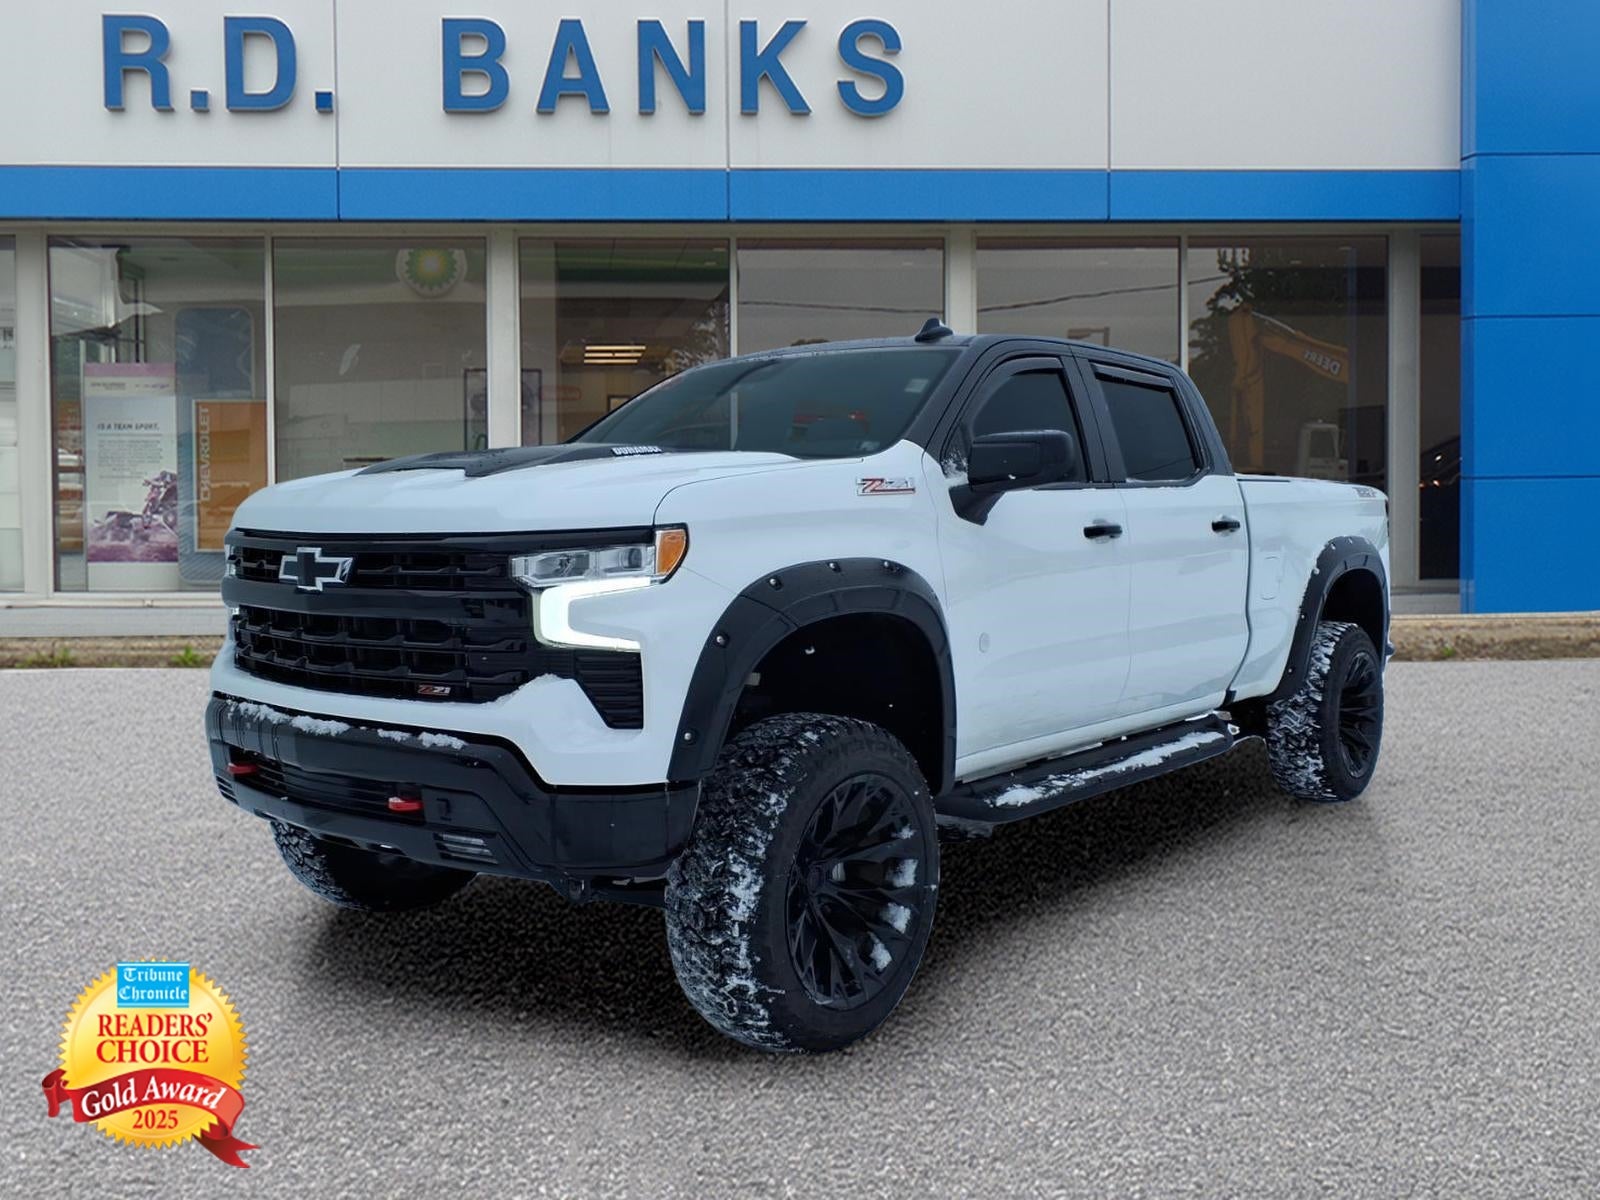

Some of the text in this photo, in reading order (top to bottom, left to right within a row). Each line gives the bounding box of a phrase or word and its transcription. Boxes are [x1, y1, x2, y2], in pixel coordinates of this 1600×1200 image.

[102, 14, 906, 117] R.D. BANKS
[200, 406, 211, 500] CHEVROLET
